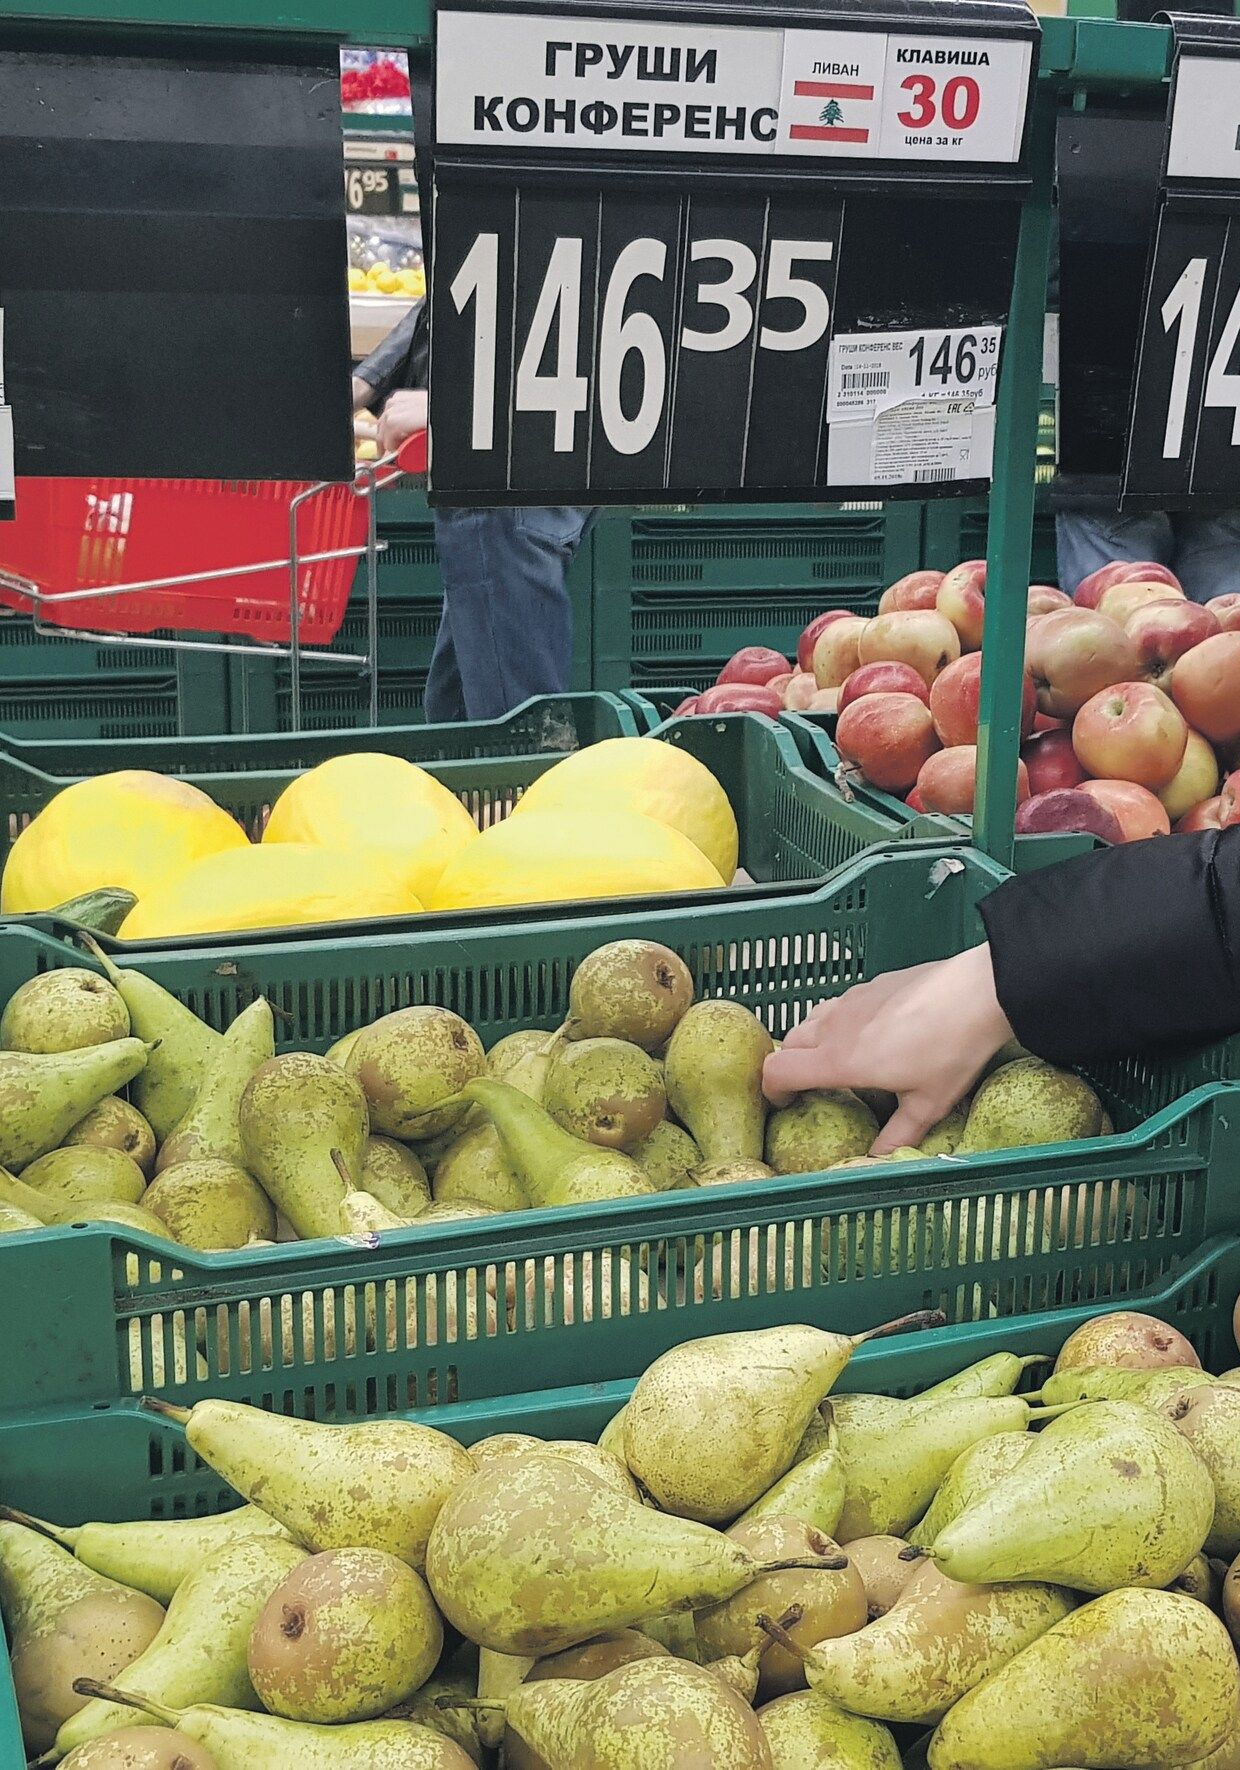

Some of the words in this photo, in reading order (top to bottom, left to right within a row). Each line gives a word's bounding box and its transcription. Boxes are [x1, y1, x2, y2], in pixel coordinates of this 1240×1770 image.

[544, 41, 718, 84] ГРУШИ
[812, 61, 859, 77] ЛИВАН
[896, 48, 990, 66] КЛАВИША
[474, 95, 779, 142] КОНФЕРЕНС
[896, 74, 981, 129] 30
[905, 135, 932, 146] цена
[935, 136, 948, 146] за
[952, 136, 964, 146] кг
[345, 170, 363, 209] 6
[362, 170, 389, 192] 95
[449, 232, 668, 456] 146
[680, 239, 834, 353] 35
[909, 334, 978, 387] 146
[980, 337, 996, 354] 35
[978, 363, 997, 381] руб
